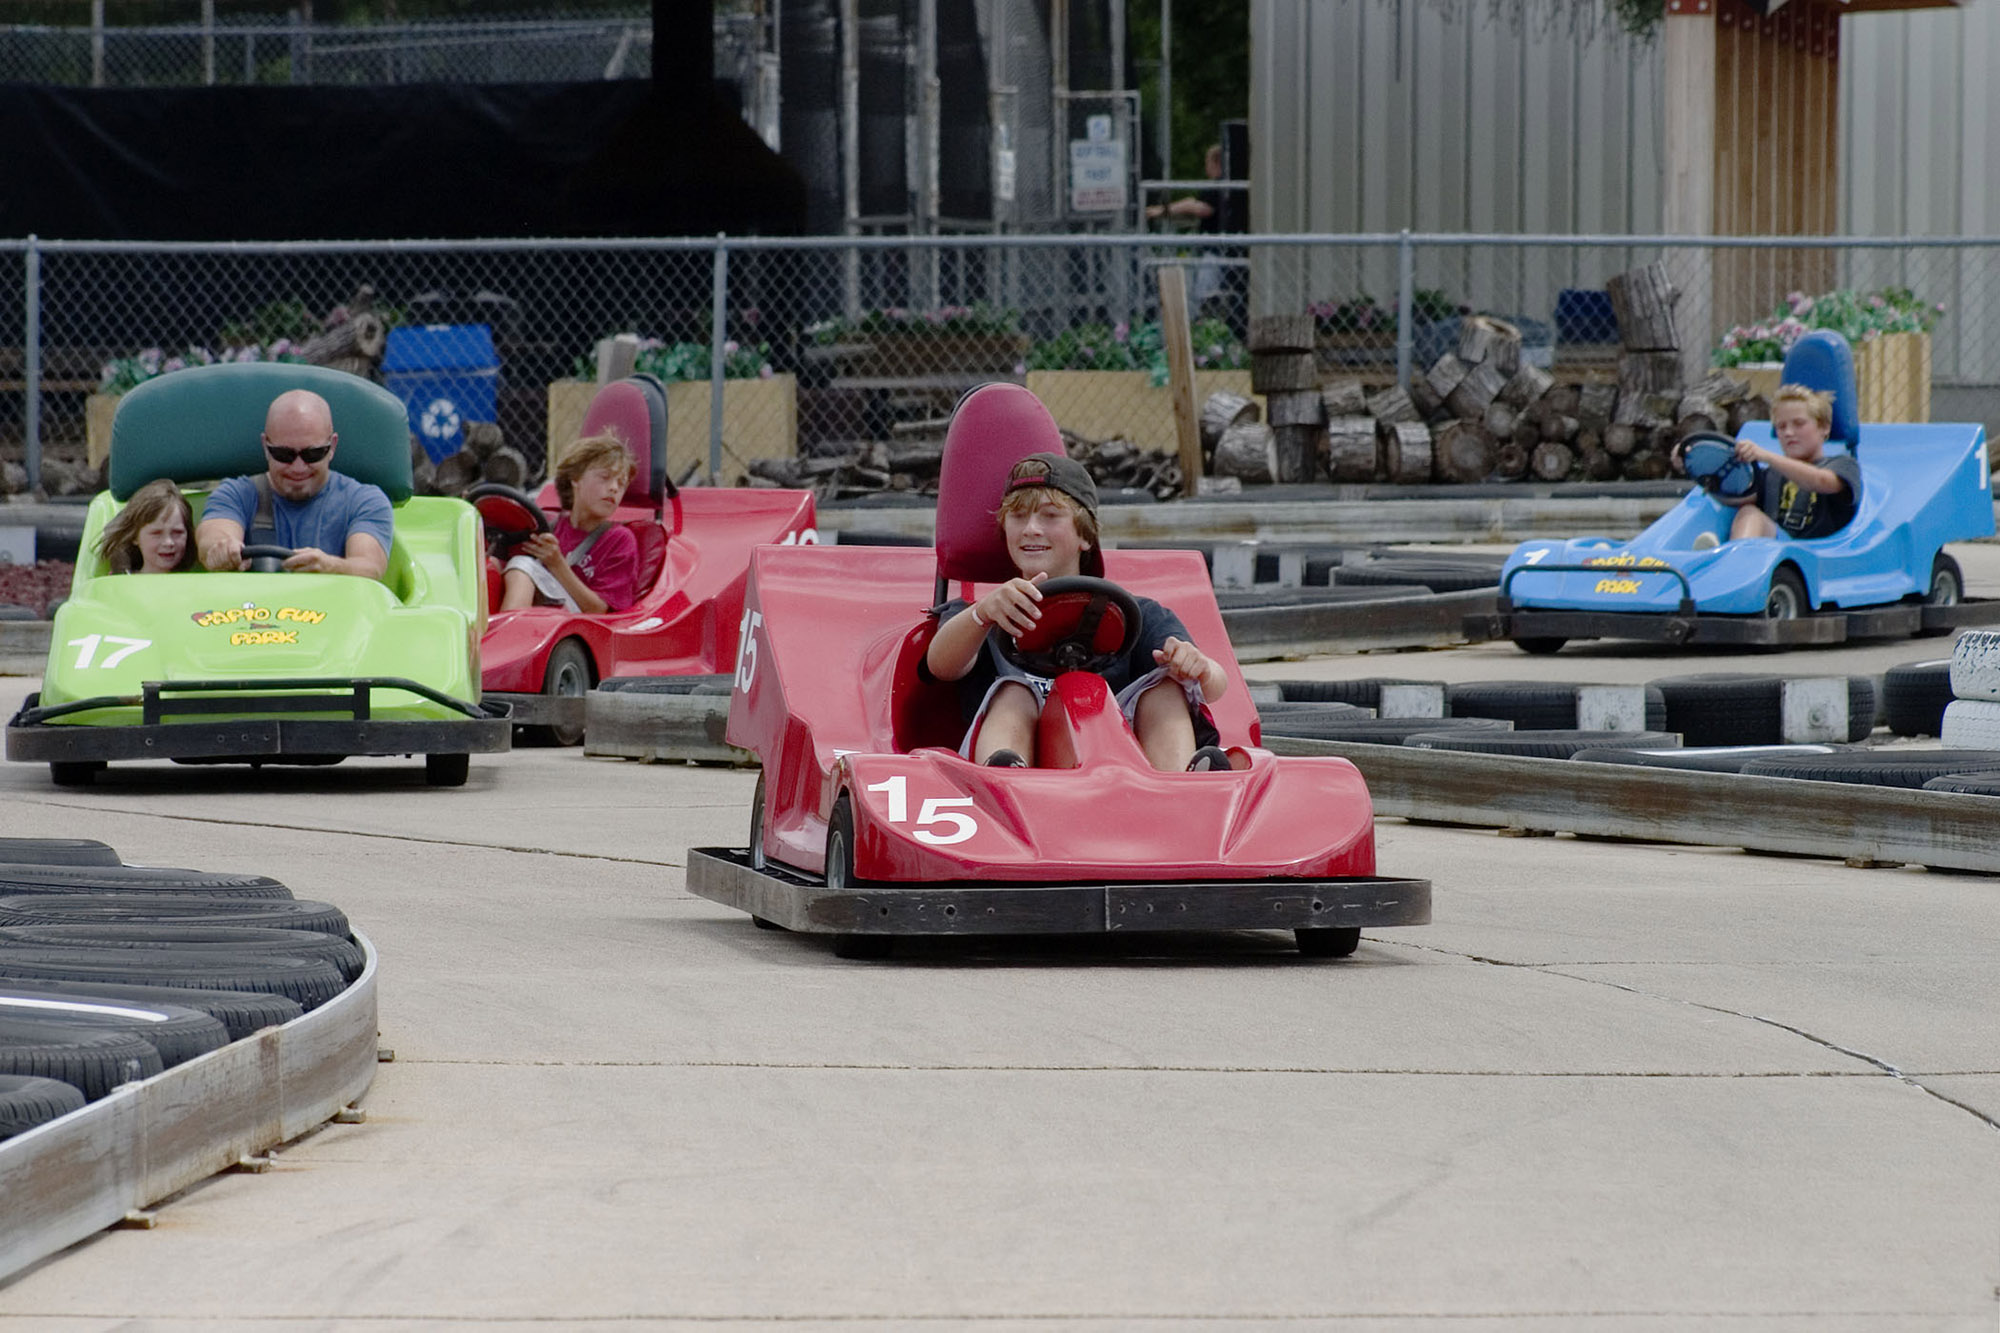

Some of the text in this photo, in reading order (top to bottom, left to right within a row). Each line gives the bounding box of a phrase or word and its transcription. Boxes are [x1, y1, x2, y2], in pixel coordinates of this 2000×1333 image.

[1975, 442, 1987, 488] 1
[1524, 548, 1550, 574] 1
[1594, 579, 1642, 594] PARK
[275, 607, 327, 624] FUN
[67, 633, 153, 669] 17
[230, 630, 299, 646] PARK
[734, 607, 763, 694] 15
[867, 775, 978, 845] 15
